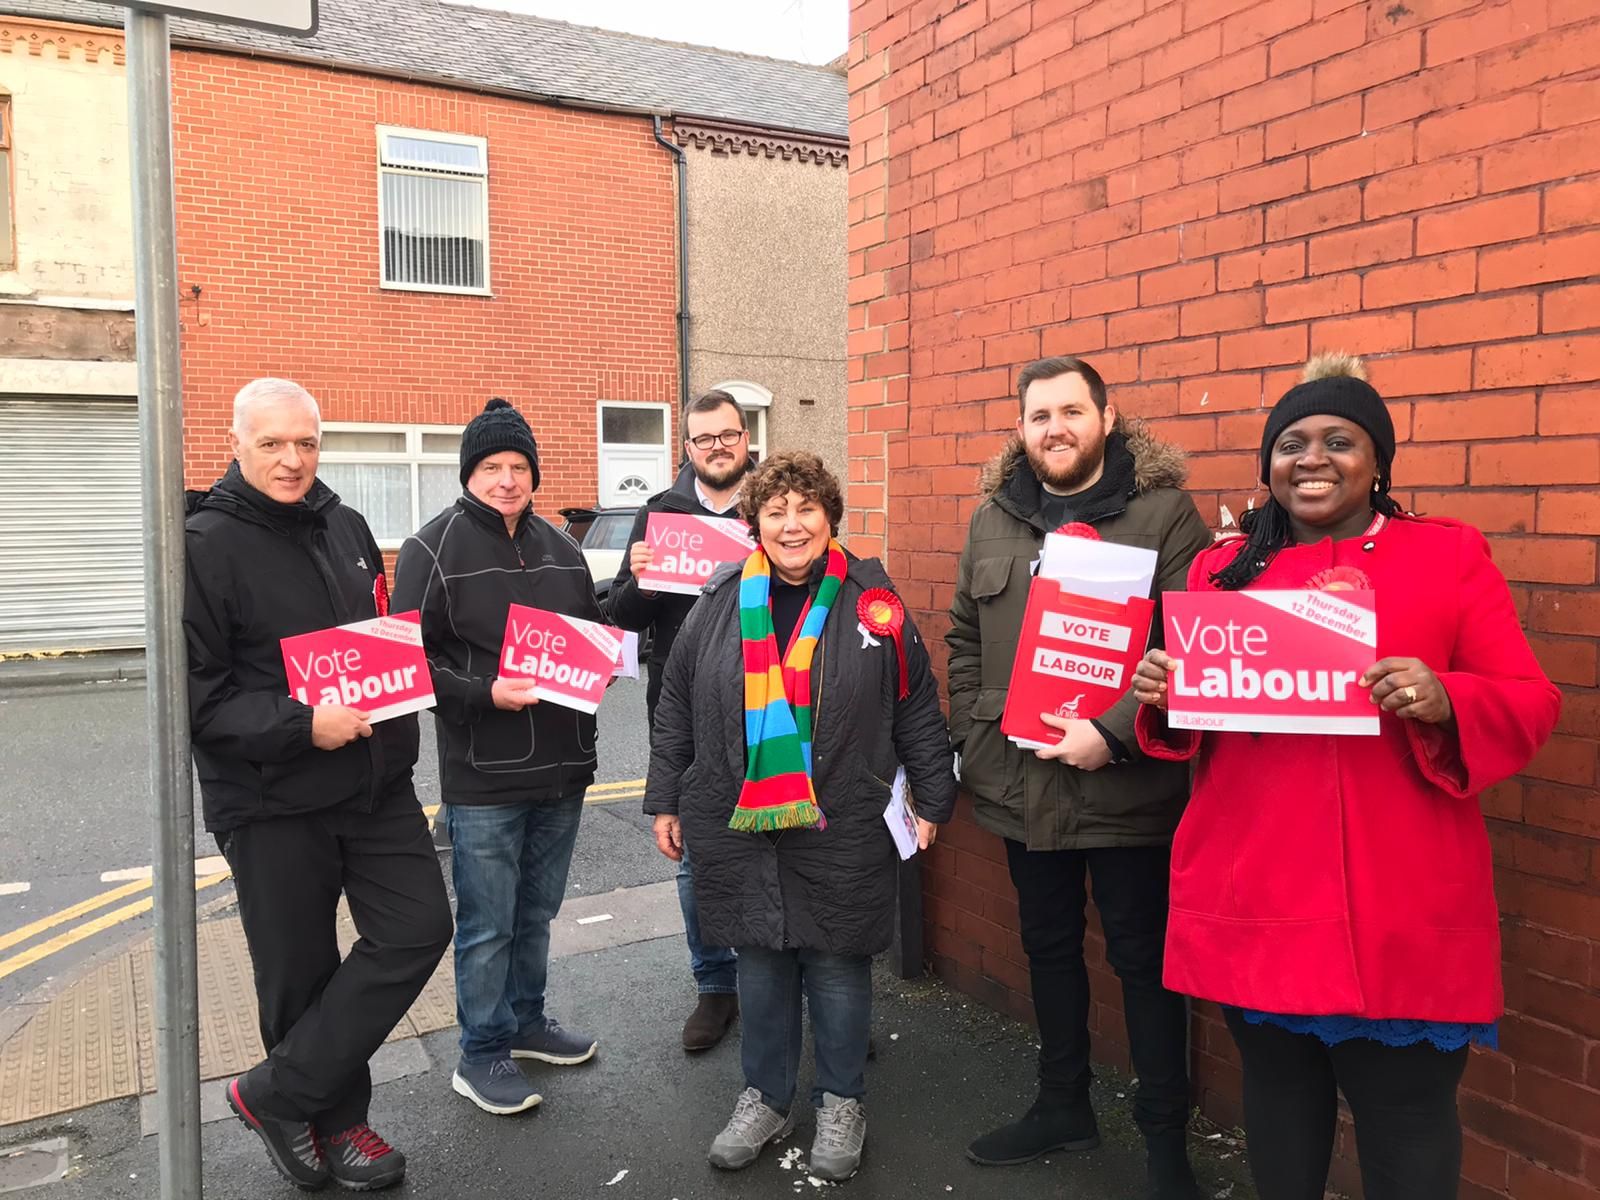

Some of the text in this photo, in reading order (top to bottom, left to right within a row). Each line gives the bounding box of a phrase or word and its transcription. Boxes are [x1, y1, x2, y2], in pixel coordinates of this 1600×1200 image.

[651, 525, 703, 551] Vote
[645, 551, 721, 577] abo
[1292, 602, 1368, 638] 12 December
[1307, 594, 1362, 624] Thursday
[379, 619, 414, 634] Thursday
[380, 629, 418, 642] December
[512, 619, 567, 655] Vote
[1062, 621, 1111, 642] VOTE
[1171, 616, 1269, 656] Vote
[290, 648, 362, 682] Vote
[504, 646, 602, 691] Labour
[1039, 654, 1116, 681] LABOUR
[1174, 659, 1357, 702] Labour
